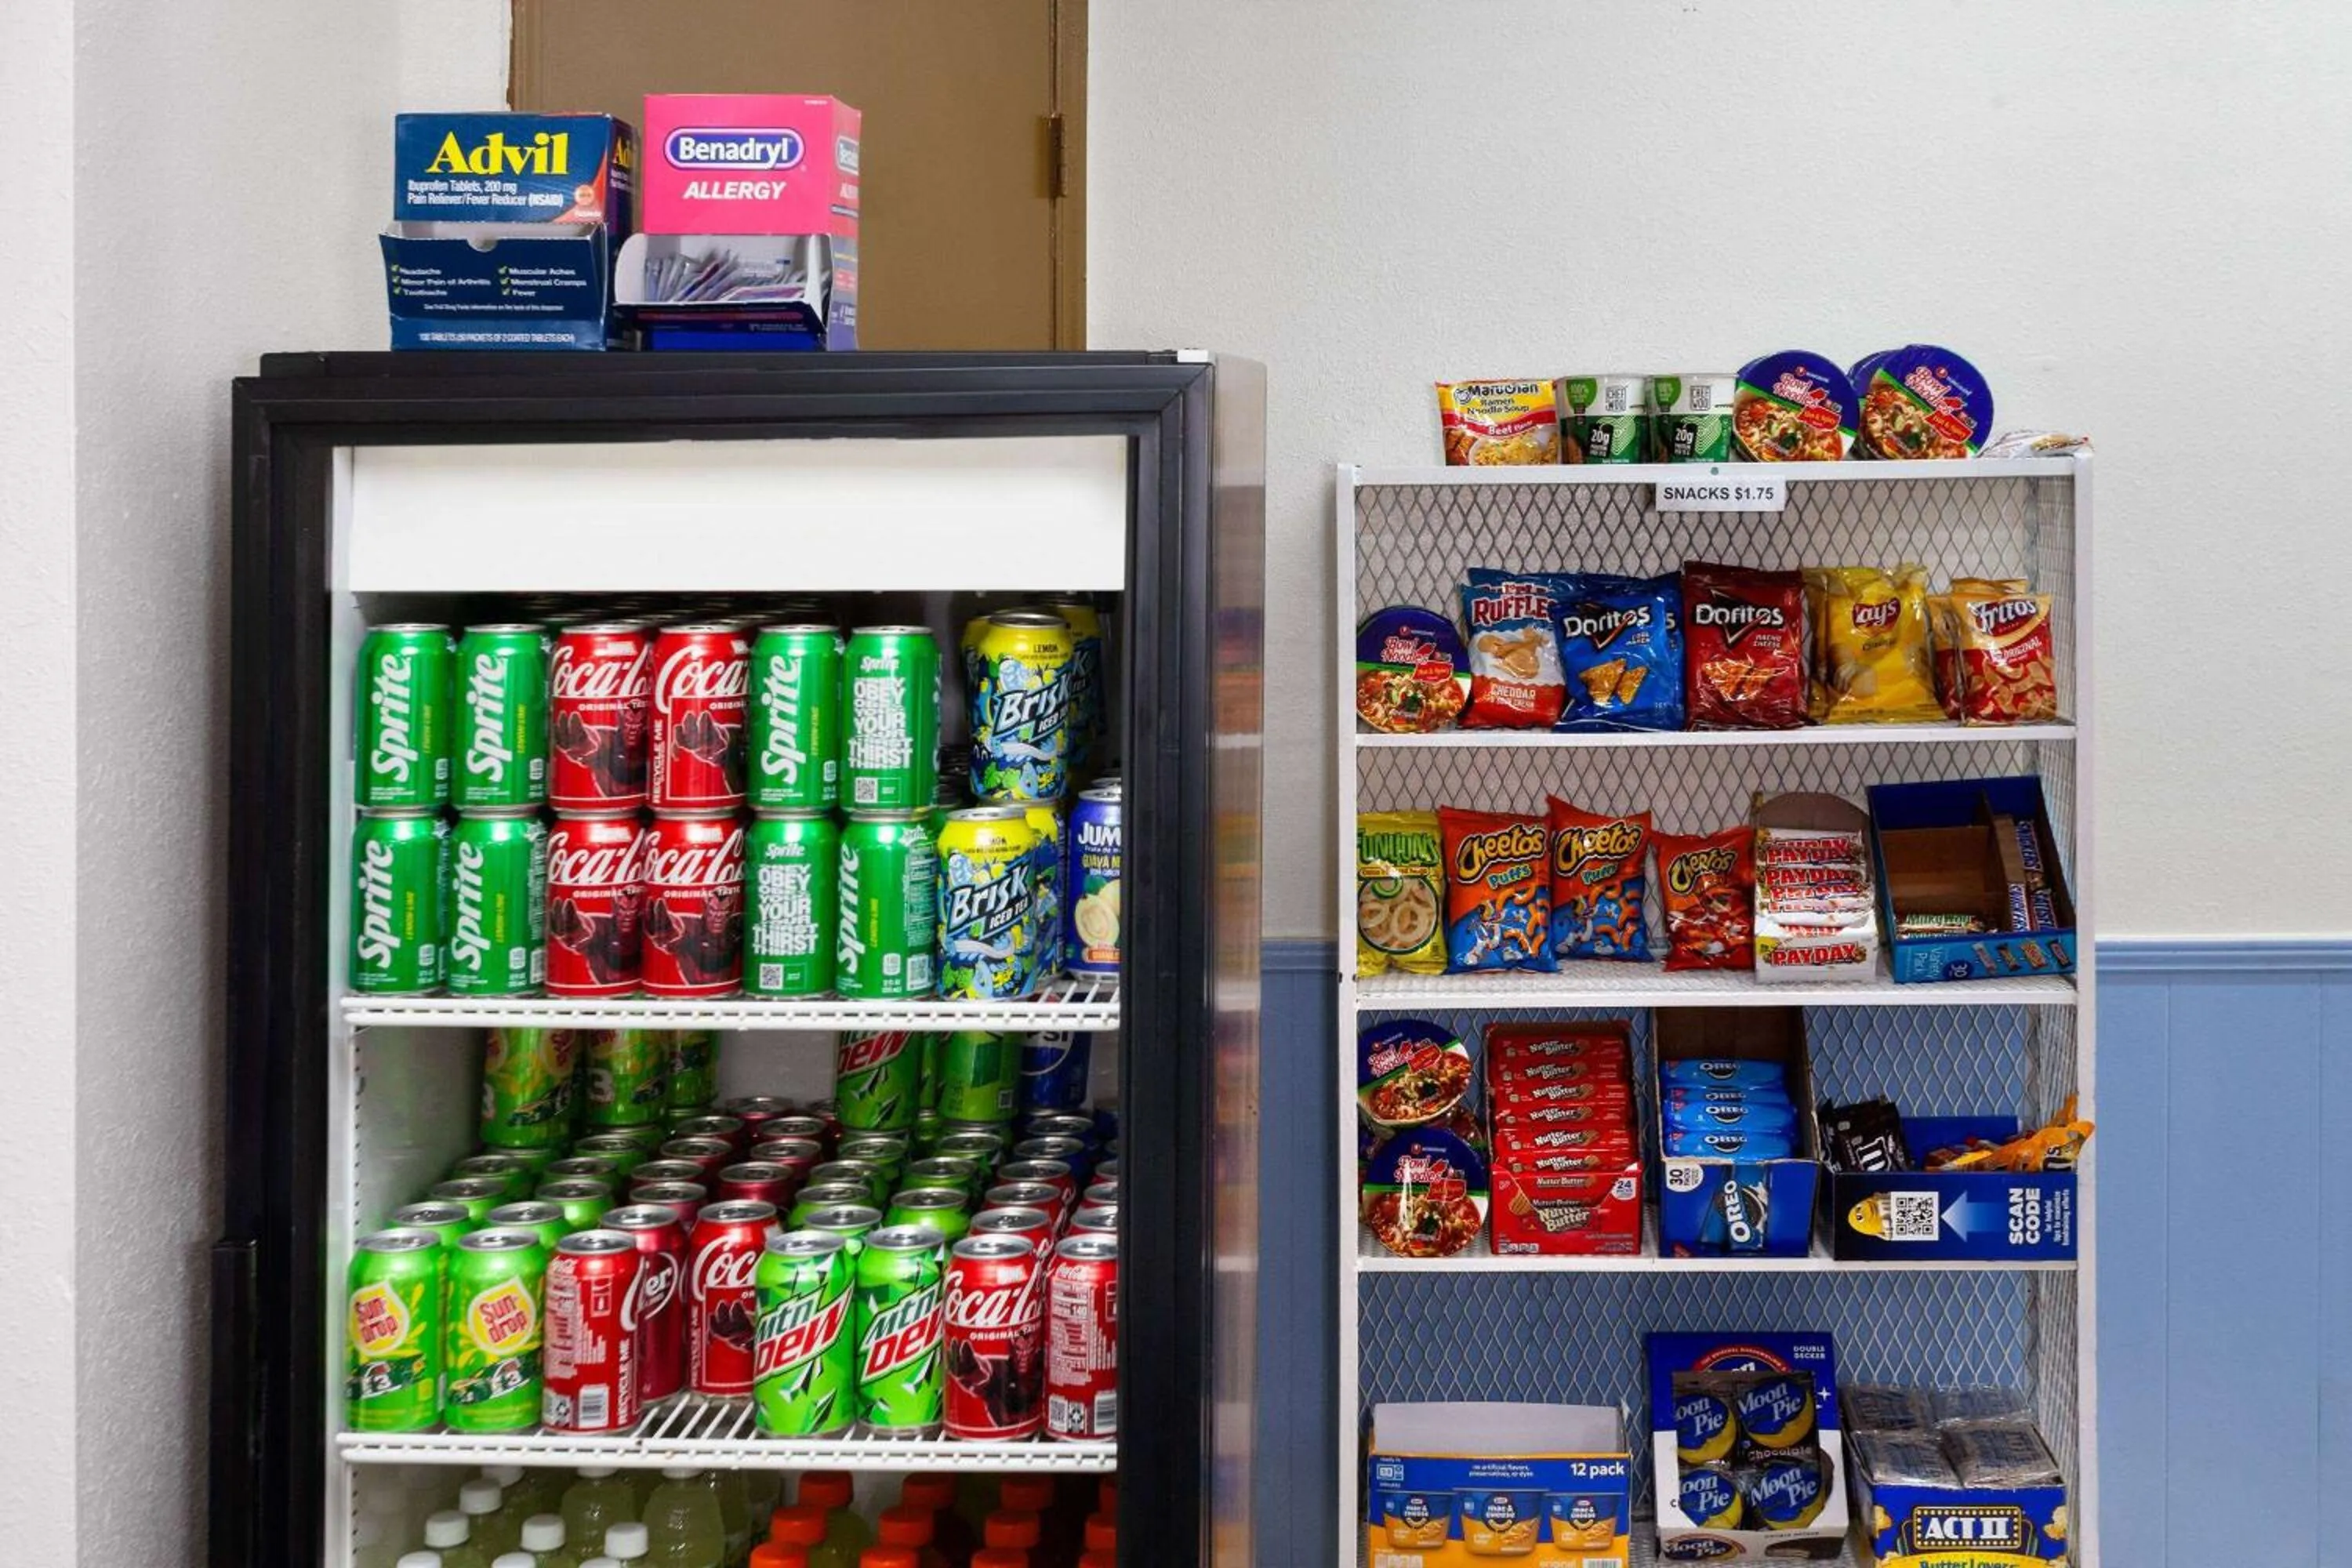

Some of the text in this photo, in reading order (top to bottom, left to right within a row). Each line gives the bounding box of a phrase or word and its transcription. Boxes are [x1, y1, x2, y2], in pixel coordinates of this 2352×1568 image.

[424, 131, 569, 175] Advil
[678, 137, 789, 170] Benadryl
[407, 193, 427, 205] Pain
[484, 180, 501, 192] 200
[502, 183, 517, 194] mg
[682, 181, 786, 199] ALLERGY
[1468, 383, 1538, 397] Maruchan
[1479, 397, 1515, 406] Ramen
[1489, 425, 1512, 435] Beef
[1591, 430, 1610, 445] 20g
[1675, 430, 1693, 445] 20g
[1663, 486, 1774, 502] SNACKS $1.75
[1563, 604, 1651, 637] Doritos
[1695, 603, 1784, 626] Doritos
[854, 677, 906, 706] OBEY
[371, 654, 419, 782] Sprite
[466, 653, 513, 782] Sprite
[653, 719, 663, 741] ME
[760, 655, 806, 785] Sprite
[854, 709, 906, 736] YOUR
[1038, 711, 1059, 732] ICED
[848, 737, 913, 769] THIRST
[1077, 821, 1121, 847] JUM
[765, 843, 805, 859] Sprite
[1458, 824, 1544, 882] Cheetos
[1556, 822, 1640, 873] Cheetos
[1766, 848, 1852, 865] PAYDAY
[758, 864, 811, 895] OBEY
[1670, 848, 1736, 892] Cheetos
[1766, 867, 1859, 886] PAYDAY
[358, 840, 401, 969] Sprite
[452, 841, 491, 971] Sprite
[758, 896, 811, 924] YOUR
[989, 897, 1029, 929] ICED TEA
[753, 924, 818, 956] THIRST
[1770, 942, 1857, 967] PAYDAY
[1951, 963, 1969, 978] 30
[1705, 1105, 1749, 1115] OREO
[1704, 1134, 1748, 1144] OREO
[1617, 1180, 1632, 1189] 24
[1669, 1169, 1683, 1185] 30
[1544, 1211, 1590, 1232] Butter
[1724, 1180, 1751, 1243] OREO
[2008, 1188, 2024, 1245] SCAN
[2025, 1188, 2041, 1245] CODE
[479, 1294, 518, 1322] Sun
[361, 1315, 399, 1344] drop
[488, 1312, 528, 1345] drop
[1675, 1396, 1711, 1421] oon
[1737, 1382, 1788, 1415] Moon
[1772, 1396, 1802, 1422] Pie
[1694, 1412, 1723, 1437] Pie
[1570, 1462, 1625, 1479] 12 pack
[1682, 1475, 1718, 1494] oon
[1750, 1467, 1802, 1506] Moon
[1788, 1480, 1817, 1508] Pie
[1698, 1490, 1730, 1512] Pie
[1925, 1516, 2009, 1540] ACT II
